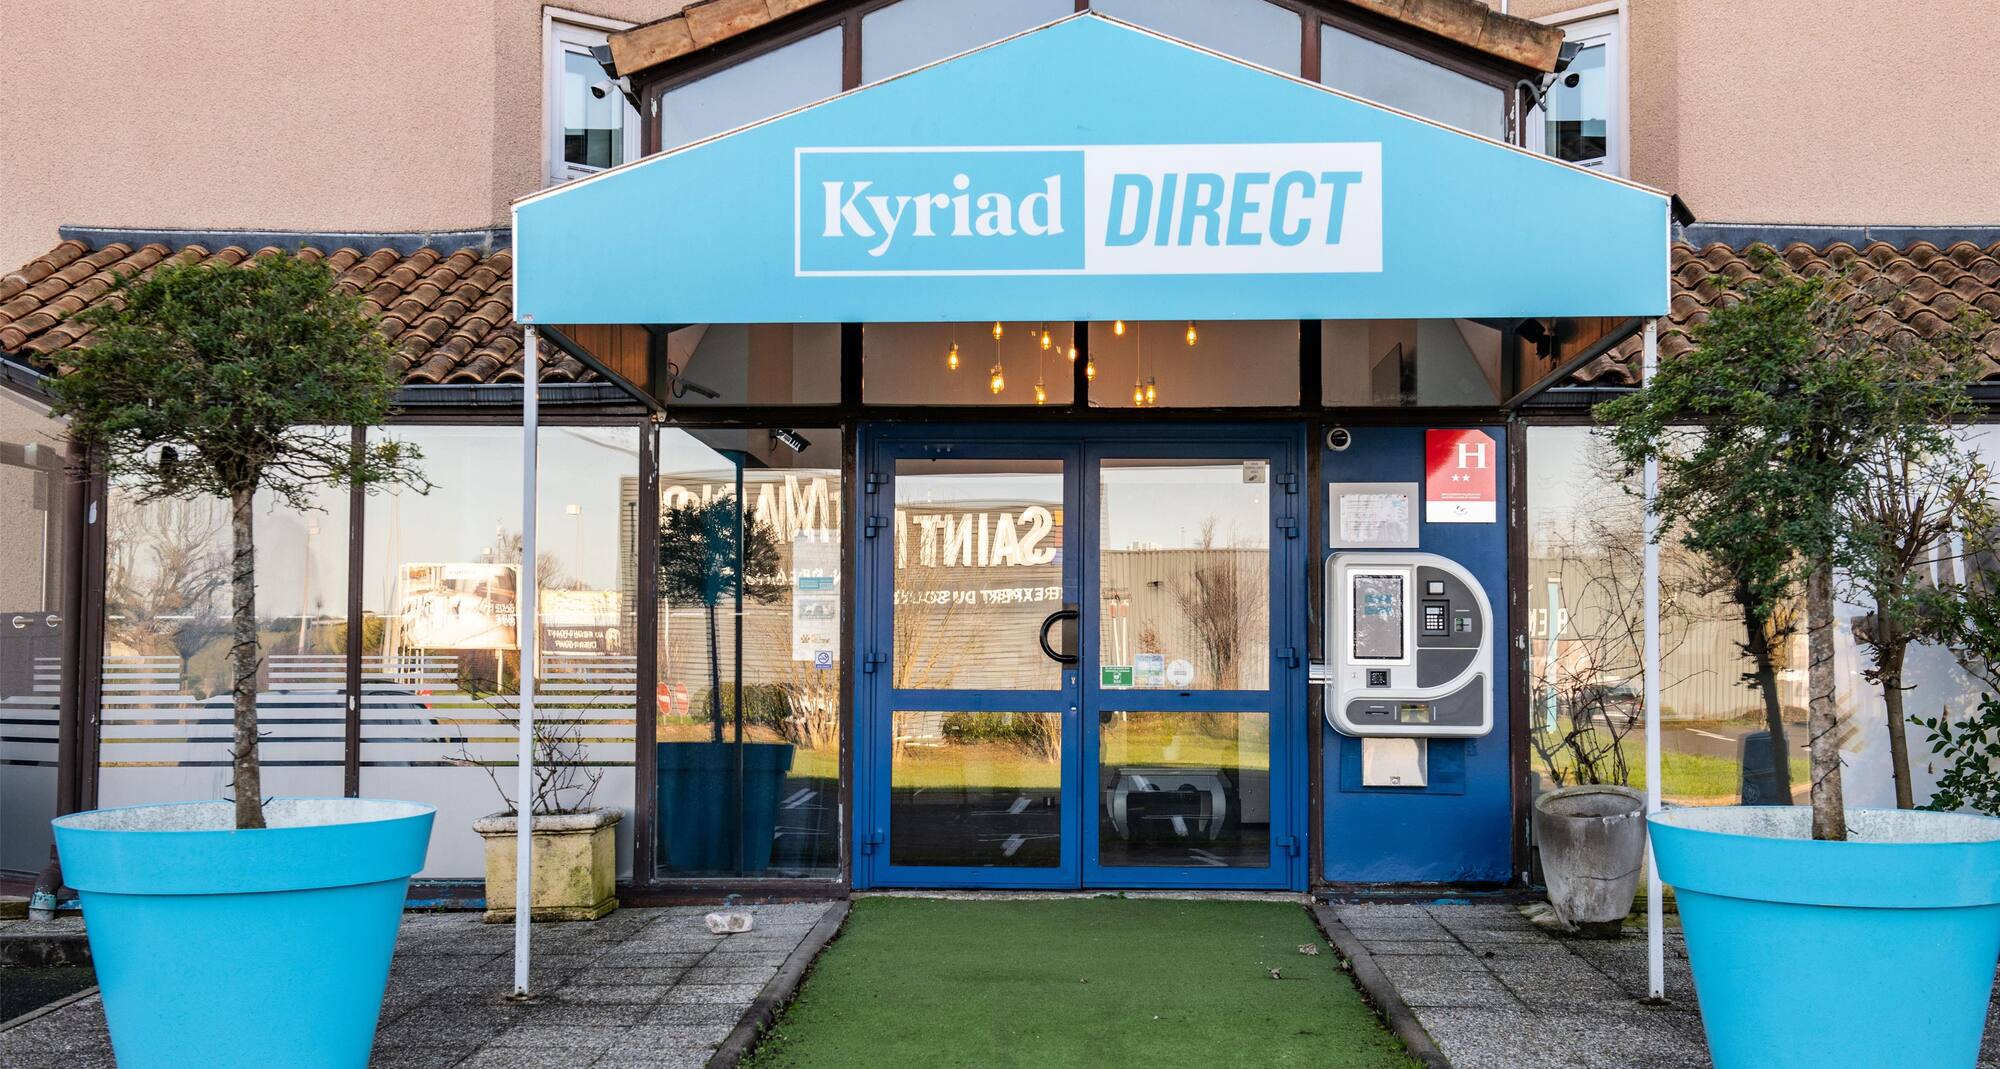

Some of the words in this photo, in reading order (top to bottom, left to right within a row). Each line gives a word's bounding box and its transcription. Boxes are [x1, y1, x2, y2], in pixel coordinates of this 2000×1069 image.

[821, 173, 1065, 257] Kyriad
[1104, 170, 1363, 247] DIRECT
[1456, 443, 1489, 469] H
